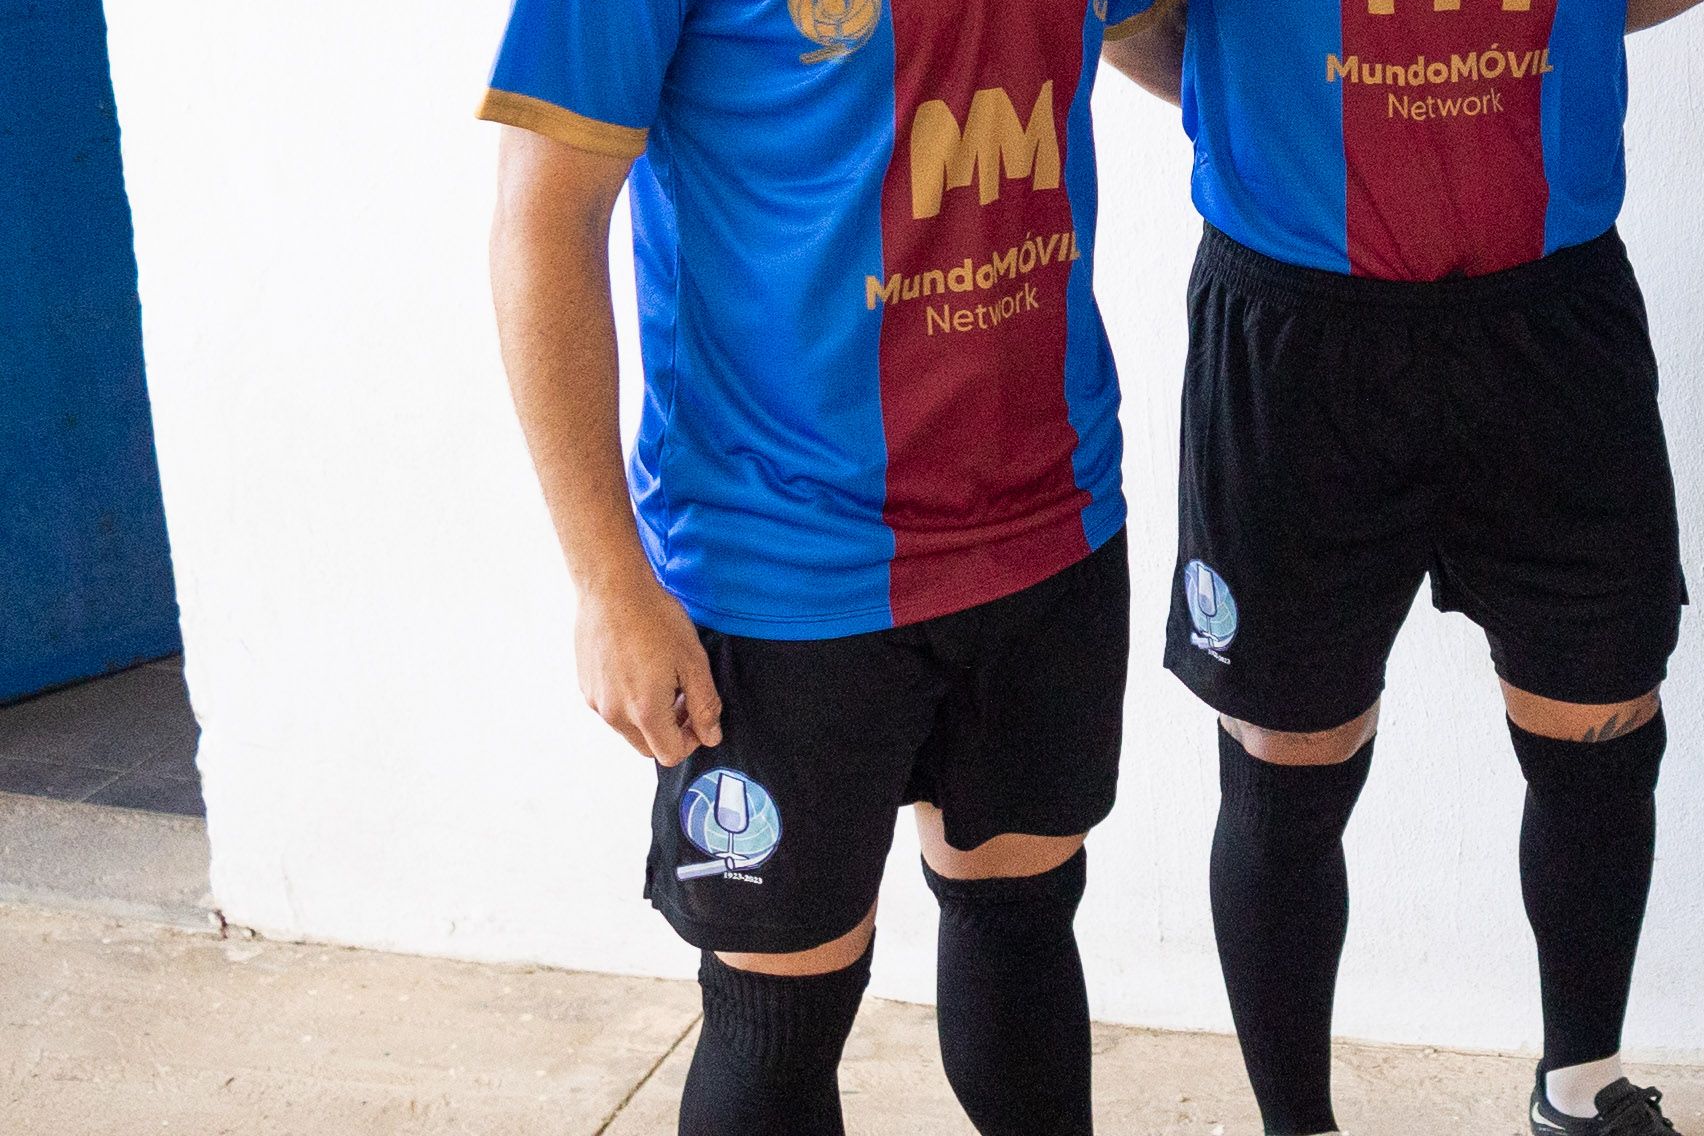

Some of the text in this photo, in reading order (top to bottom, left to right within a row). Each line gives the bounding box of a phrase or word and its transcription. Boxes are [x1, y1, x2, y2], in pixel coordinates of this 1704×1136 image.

[1325, 43, 1554, 87] MundoMÓVIL
[1387, 88, 1504, 121] Network
[865, 230, 1080, 311] MundoMÓVIL
[925, 284, 1039, 336] Network
